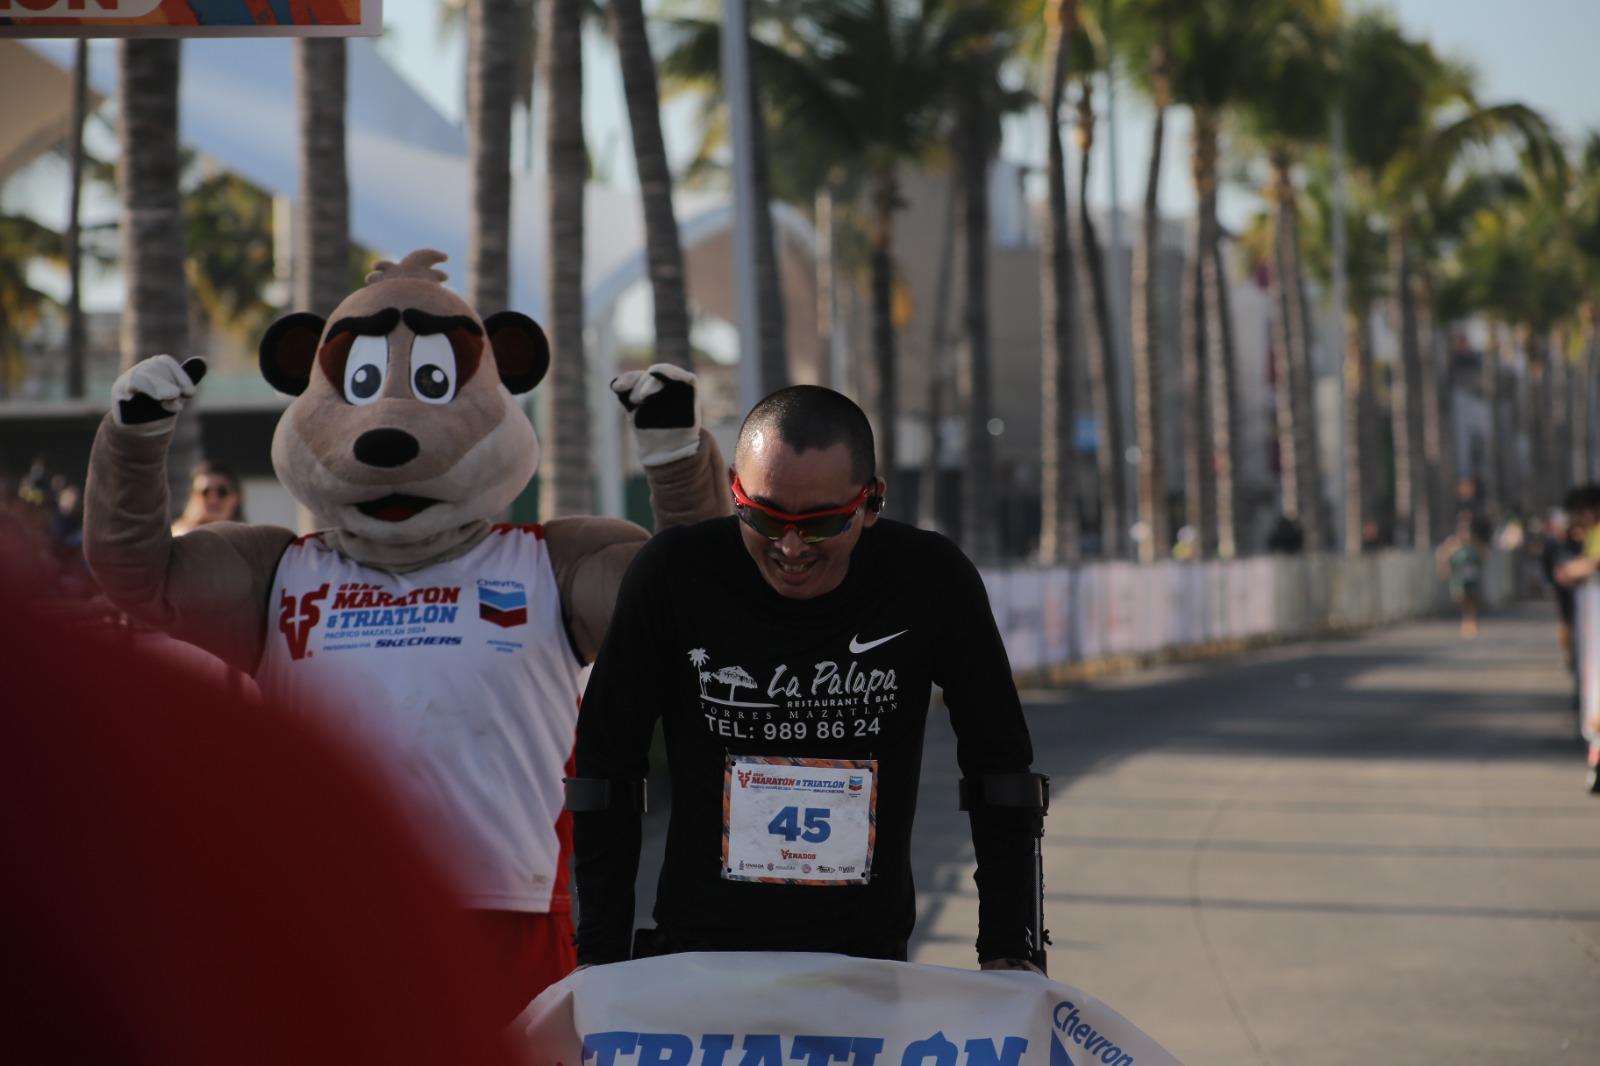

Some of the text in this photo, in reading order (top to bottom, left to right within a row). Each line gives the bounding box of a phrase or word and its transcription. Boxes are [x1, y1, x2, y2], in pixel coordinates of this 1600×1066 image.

[374, 636, 462, 648] SKECHERS
[767, 661, 898, 704] La Palapa
[700, 702, 772, 720] TORRES
[787, 694, 895, 708] RESTAURANT BAR
[705, 714, 880, 740] TEL: 989 86 24
[768, 806, 831, 843] 45
[1053, 1001, 1134, 1066] Chevron
